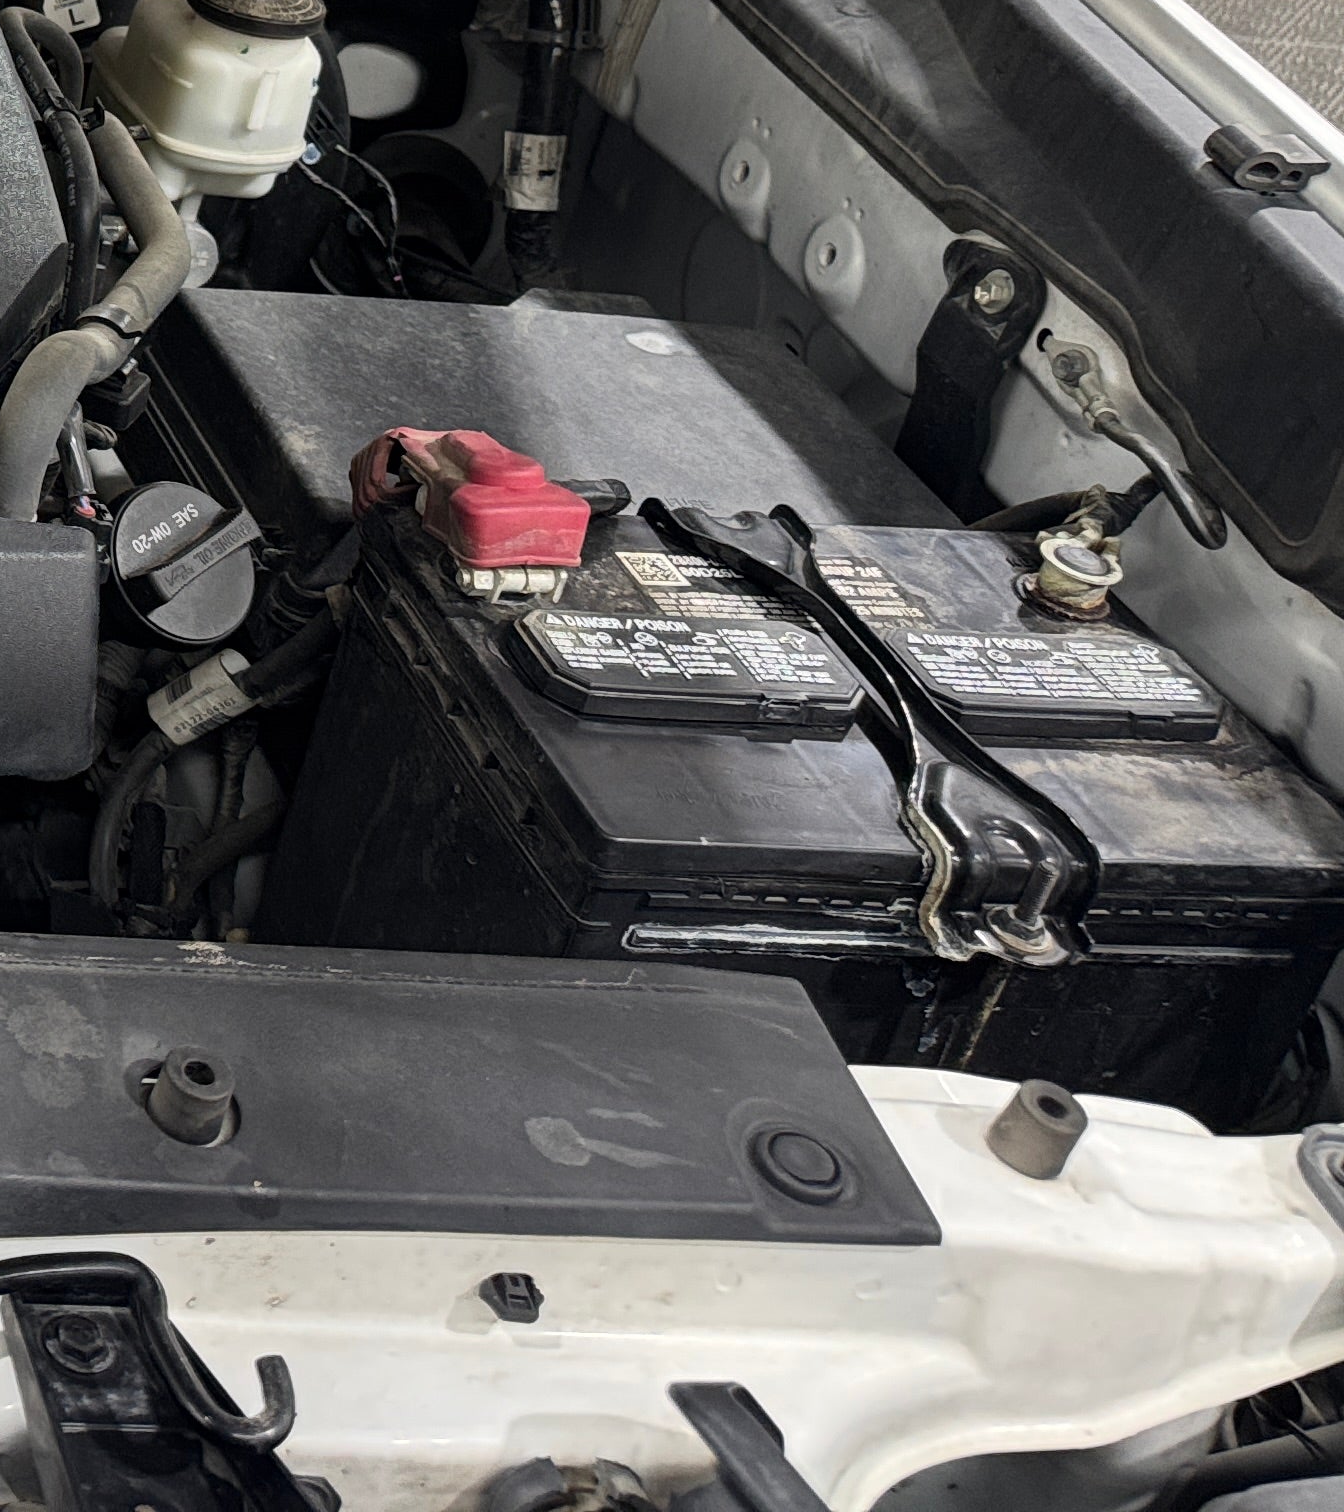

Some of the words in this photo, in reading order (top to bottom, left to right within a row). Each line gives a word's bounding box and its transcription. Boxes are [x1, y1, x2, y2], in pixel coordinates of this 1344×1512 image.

[172, 503, 199, 528] SAE
[132, 521, 171, 554] 0W-20
[193, 550, 214, 566] OIL
[560, 614, 624, 630] DANGER
[633, 618, 692, 633] POISON
[921, 633, 985, 648] DANGER
[991, 637, 1050, 651] POISON
